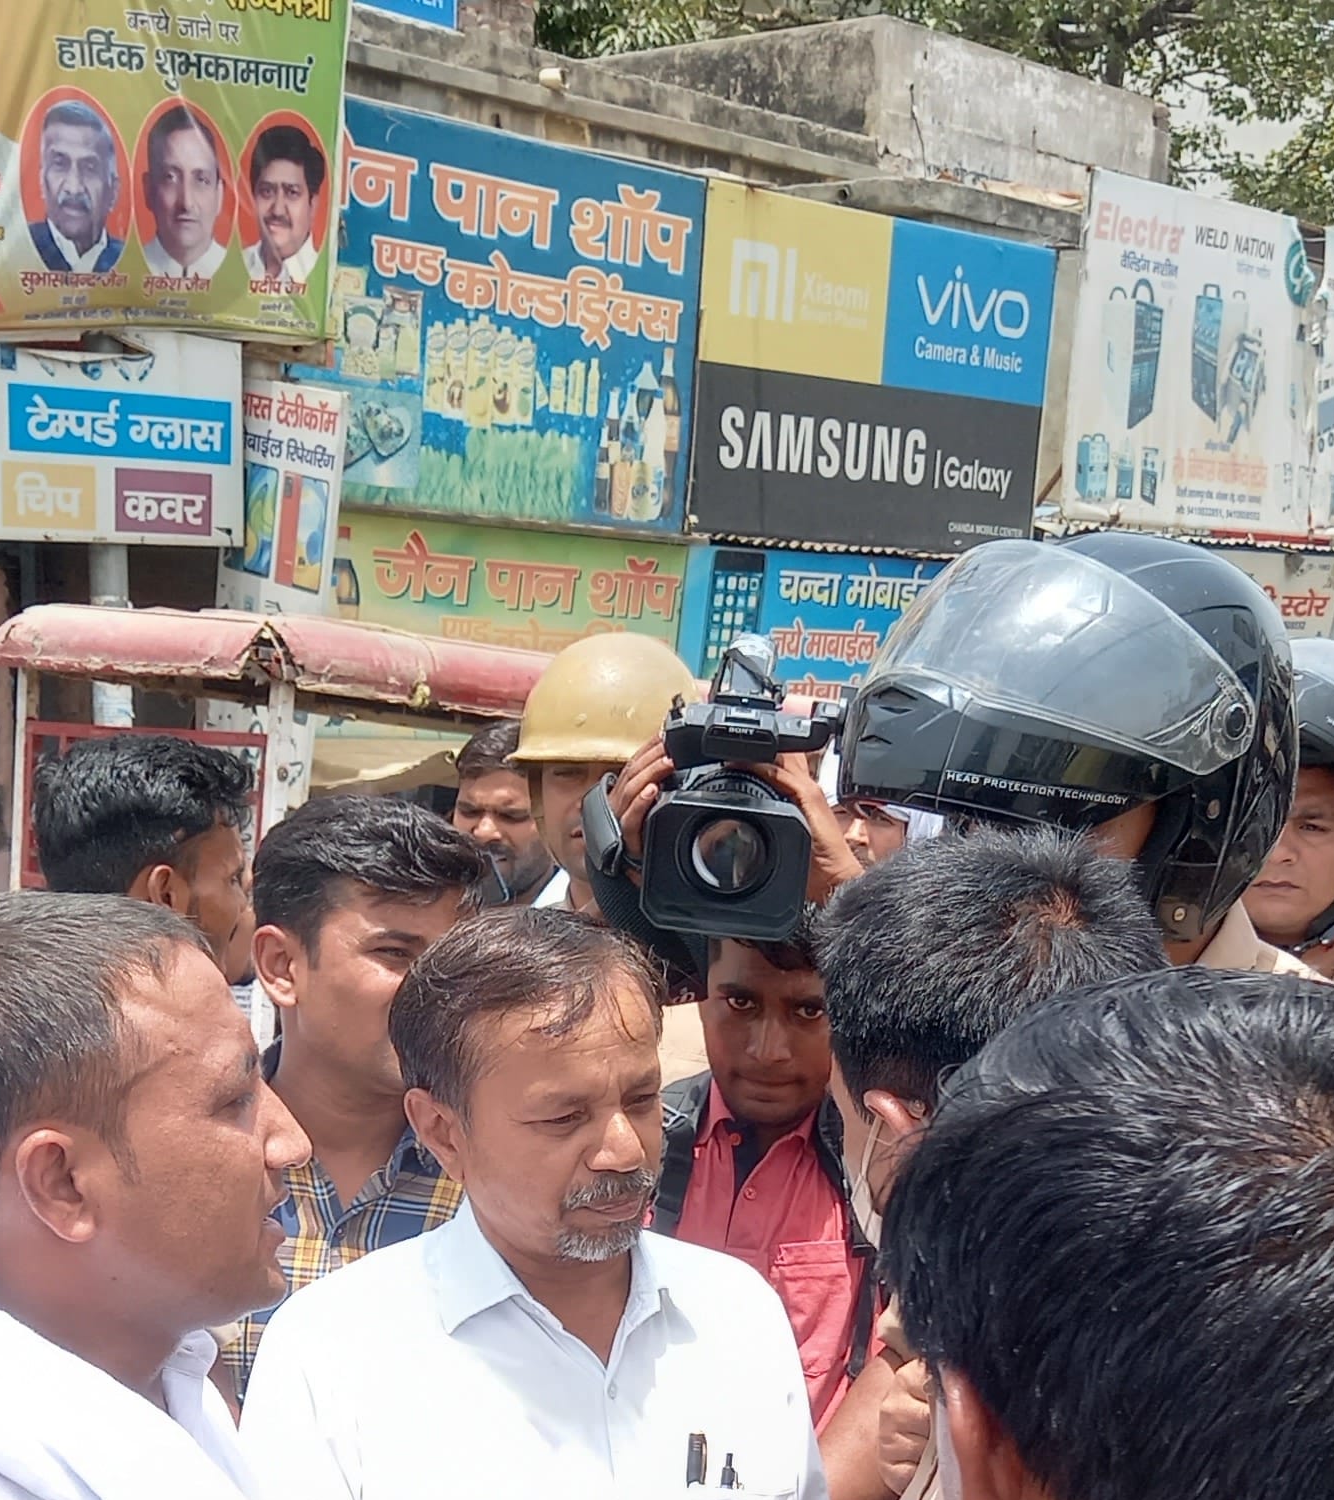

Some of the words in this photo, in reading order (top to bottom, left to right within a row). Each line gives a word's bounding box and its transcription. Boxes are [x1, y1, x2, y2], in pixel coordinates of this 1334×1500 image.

[178, 15, 212, 40] जाने
[219, 21, 241, 43] पर
[56, 27, 145, 72] हार्दिक
[155, 47, 313, 92] शुभकामनाएं
[430, 162, 559, 250] पान
[570, 184, 693, 275] शॉप
[1094, 202, 1185, 254] Electra
[1195, 225, 1228, 250] WELD
[1234, 234, 1275, 262] NATION
[914, 335, 966, 365] Camera
[969, 347, 980, 366] &
[983, 347, 1022, 373] Music
[127, 413, 225, 453] ग्लास
[718, 405, 928, 487] SAMSUNG
[943, 456, 1012, 500] Galaxy
[14, 471, 83, 520] चिप
[123, 489, 207, 526] कवर
[998, 525, 1023, 538] CENTER
[373, 529, 476, 606] जैन
[486, 559, 581, 613] पान
[589, 556, 683, 621] शॉप
[779, 569, 842, 607] चन्दा
[1281, 587, 1330, 617] स्टोर
[771, 616, 803, 659] नये
[728, 727, 754, 735] SONY
[946, 771, 979, 785] HEAD
[983, 776, 1056, 797] PROTECTION
[1058, 788, 1128, 805] TECHNOLOGY
